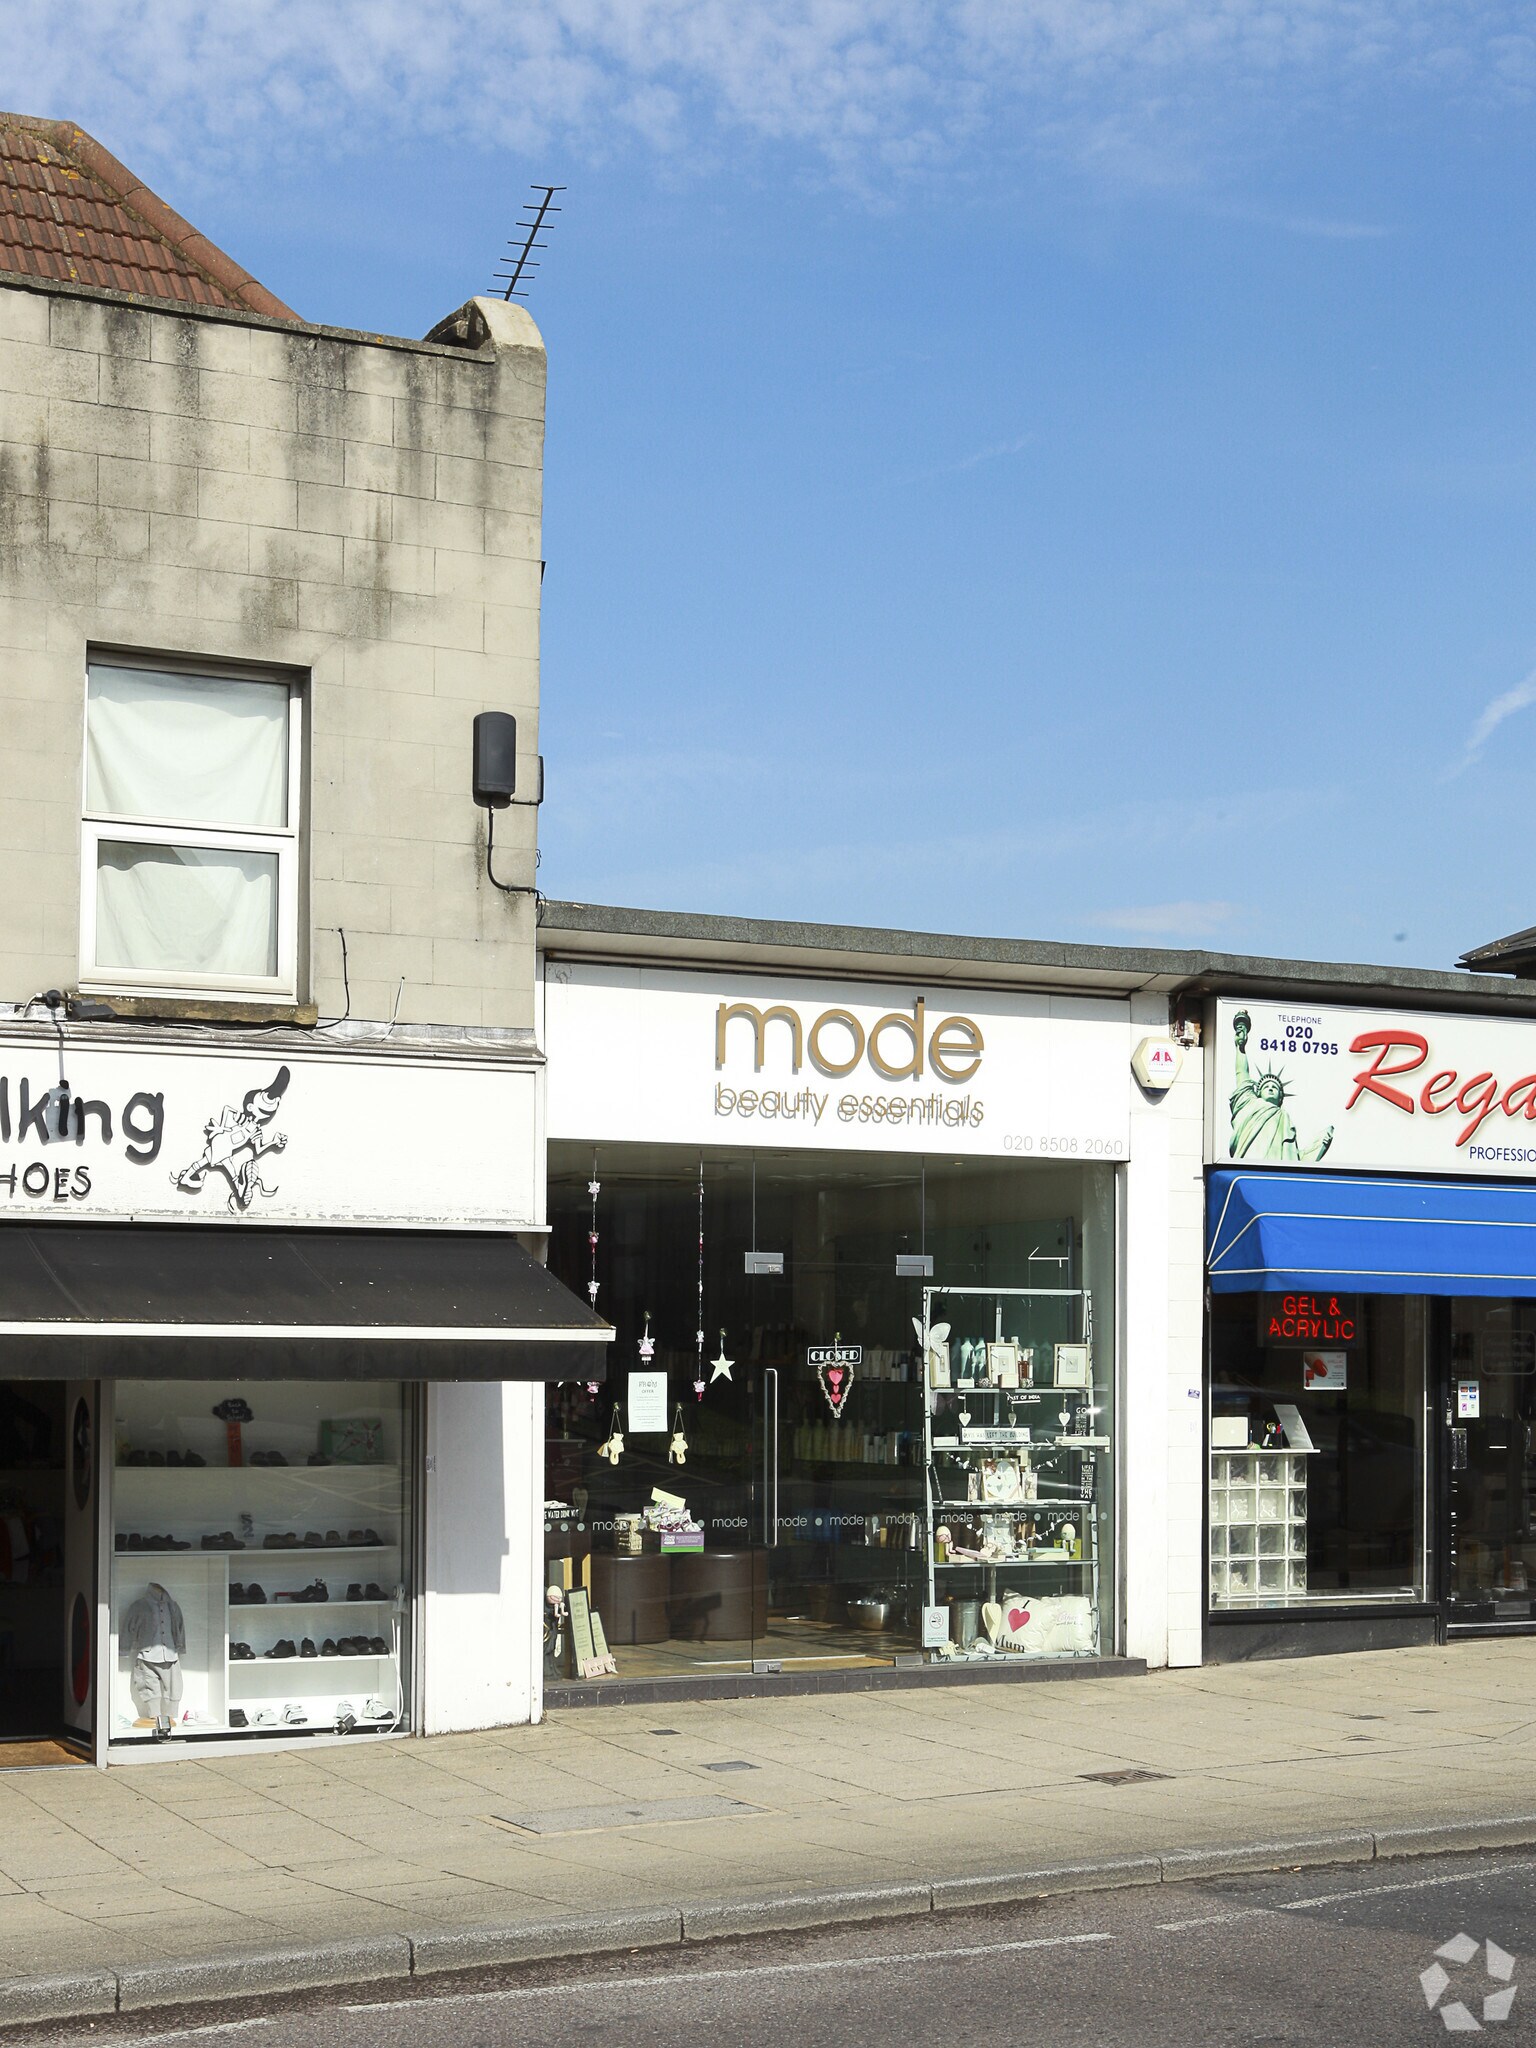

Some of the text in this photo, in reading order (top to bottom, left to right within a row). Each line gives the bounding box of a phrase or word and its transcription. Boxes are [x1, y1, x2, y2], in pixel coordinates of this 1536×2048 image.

[1278, 1014, 1322, 1024] TELEPHONE
[716, 996, 985, 1081] mode
[1285, 1025, 1313, 1039] 020
[1260, 1038, 1338, 1055] 8418 0795
[716, 1081, 985, 1127] beauty essentials
[1003, 1135, 1123, 1155] 020 8508 2060
[1469, 1146, 1536, 1162] PROFESSIO
[1283, 1295, 1341, 1316] GEL &
[1269, 1317, 1354, 1339] ACRYLIC
[810, 1350, 859, 1361] CLOSED
[712, 1516, 748, 1528] mode
[829, 1514, 864, 1526] mode
[885, 1513, 920, 1525] mode
[940, 1512, 974, 1523] mode
[1047, 1510, 1080, 1522] mode
